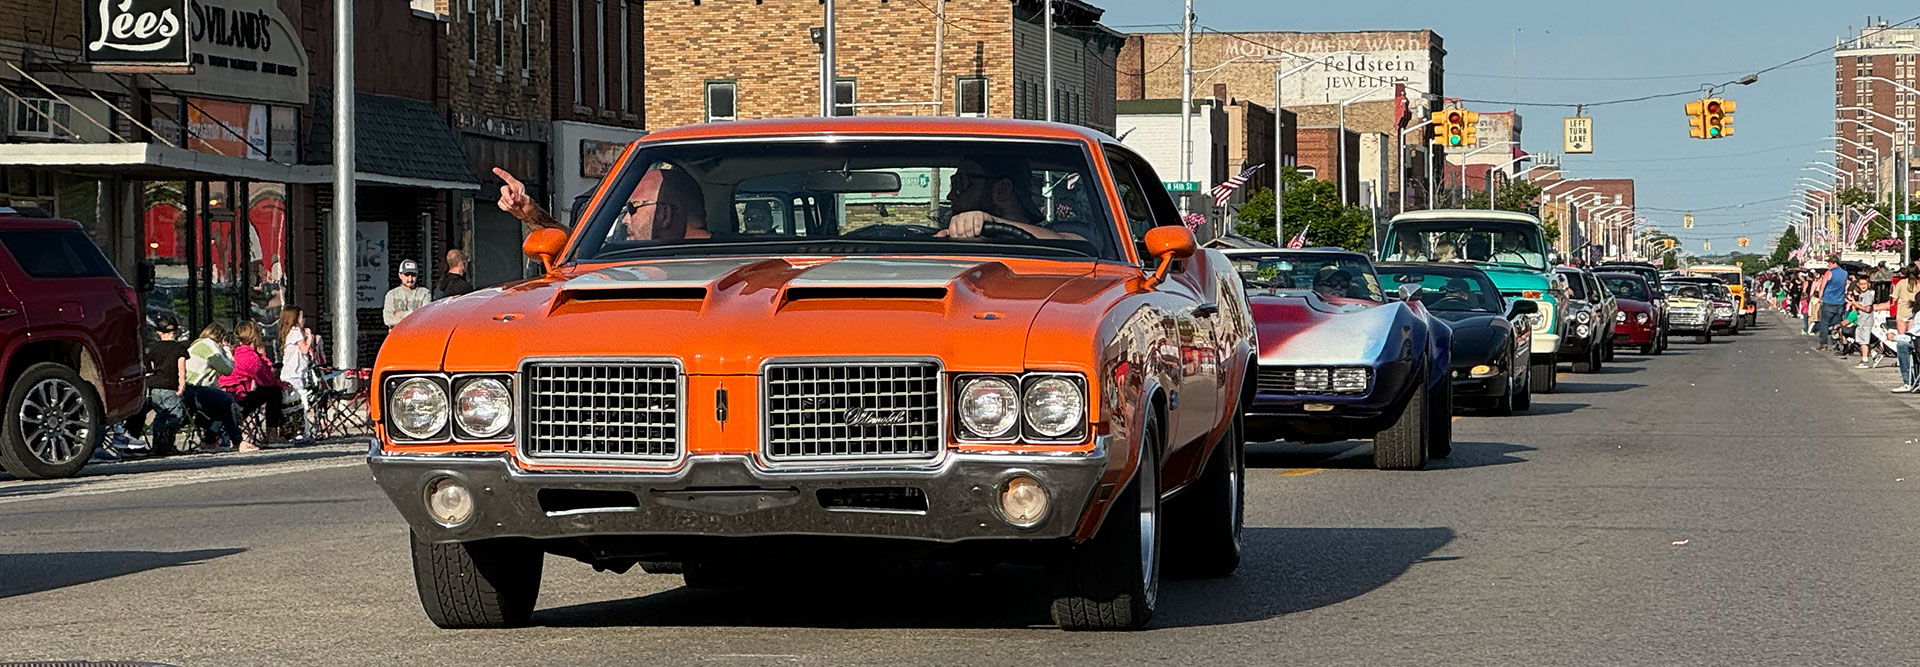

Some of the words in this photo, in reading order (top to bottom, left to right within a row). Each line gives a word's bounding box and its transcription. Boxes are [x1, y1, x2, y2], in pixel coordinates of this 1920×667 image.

[89, 0, 179, 51] Lees
[1365, 37, 1421, 51] WARD
[1324, 55, 1415, 72] Feldstein
[1569, 127, 1588, 135] TURN
[1569, 135, 1587, 143] LANE
